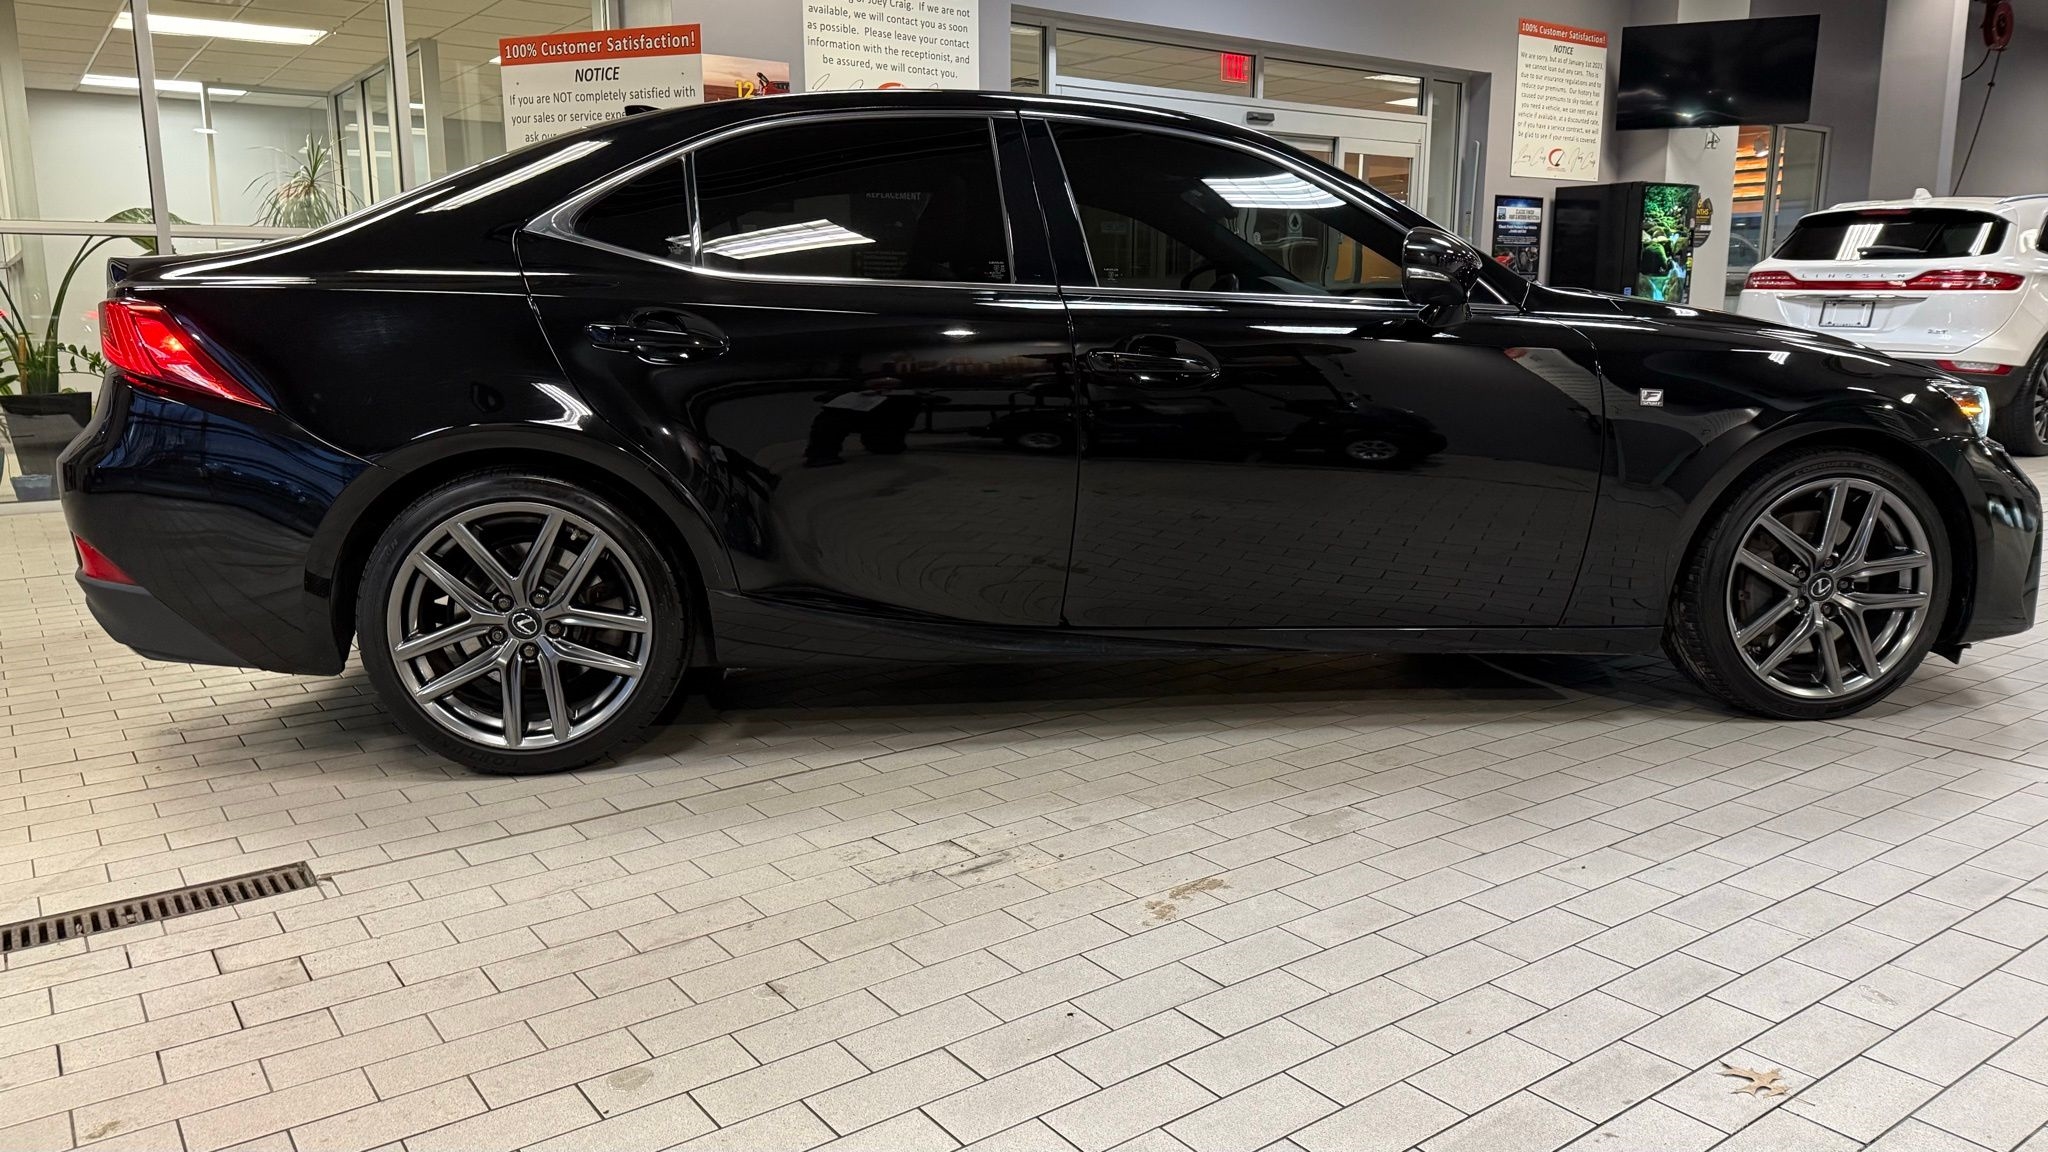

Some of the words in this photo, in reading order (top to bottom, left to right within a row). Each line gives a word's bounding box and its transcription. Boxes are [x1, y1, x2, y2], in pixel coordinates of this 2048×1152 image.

[808, 5, 851, 19] available,
[854, 11, 866, 19] we
[869, 12, 884, 22] will
[887, 15, 918, 26] contact
[920, 20, 935, 29] you
[938, 22, 946, 30] as
[949, 24, 968, 32] soon
[890, 0, 913, 11] Craig.
[919, 2, 925, 11] If
[927, 5, 939, 13] we
[941, 7, 954, 15] are
[957, 9, 970, 18] not
[807, 21, 817, 30] as
[820, 23, 859, 35] possible.
[865, 27, 892, 39] Please
[894, 30, 916, 42] leave
[919, 35, 938, 45] your
[940, 38, 970, 49] contact
[1522, 23, 1538, 32] 100%
[1540, 26, 1568, 38] Customer
[1569, 31, 1606, 44] Satisfaction!
[505, 43, 537, 59] 100%
[541, 41, 602, 56] Customer
[607, 31, 695, 52] Satisfaction!
[808, 36, 860, 51] information
[863, 44, 882, 54] with
[885, 45, 899, 56] the
[901, 49, 952, 63] receptionist,
[955, 55, 970, 64] and
[1553, 45, 1574, 55] NOTICE
[575, 66, 620, 83] NOTICE
[823, 54, 834, 64] be
[837, 59, 873, 70] assured,
[876, 62, 888, 70] we
[890, 62, 905, 72] will
[907, 66, 938, 76] contact
[940, 70, 958, 79] you.
[509, 95, 515, 105] If
[518, 97, 534, 107] you
[537, 95, 550, 104] are
[553, 92, 572, 103] NOT
[575, 89, 626, 104] completely
[630, 86, 670, 100] satisfied
[674, 85, 696, 98] with
[512, 114, 531, 126] your
[533, 112, 555, 123] sales
[558, 114, 567, 122] or
[570, 110, 602, 122] service
[525, 131, 539, 142] ask
